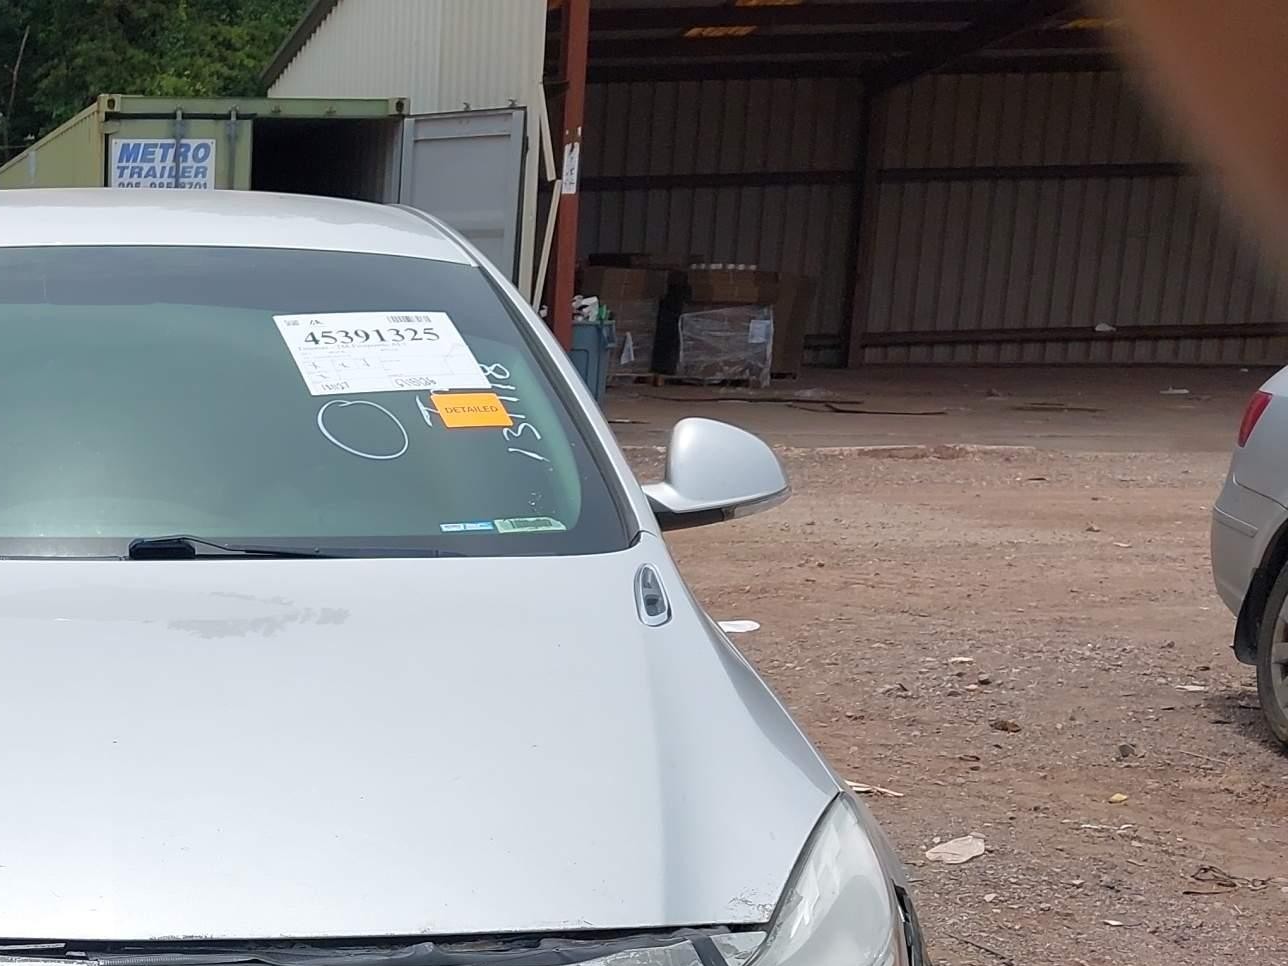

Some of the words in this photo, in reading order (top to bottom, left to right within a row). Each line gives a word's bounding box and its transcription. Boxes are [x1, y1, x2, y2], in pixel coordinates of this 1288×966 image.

[118, 143, 211, 163] METRO
[117, 166, 208, 179] TRAILER
[304, 328, 440, 345] 45391325
[445, 406, 498, 414] DETAILED
